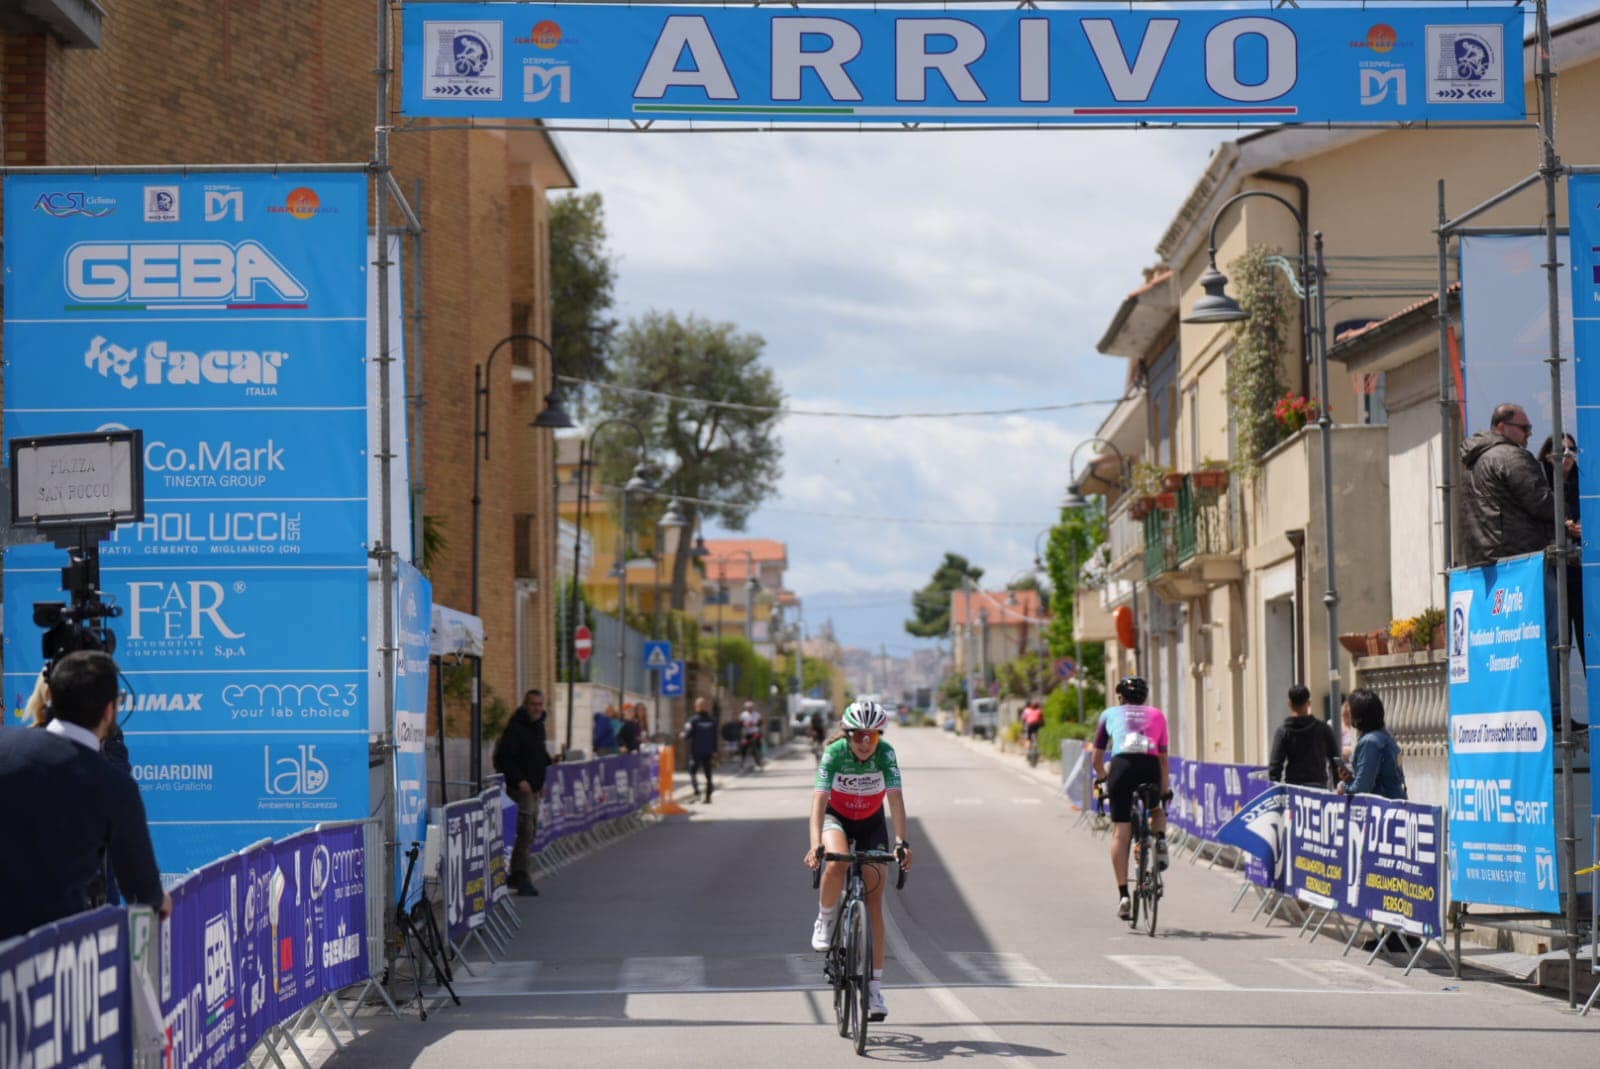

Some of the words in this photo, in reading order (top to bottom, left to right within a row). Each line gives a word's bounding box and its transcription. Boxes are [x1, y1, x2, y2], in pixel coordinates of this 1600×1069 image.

[633, 15, 1299, 103] ARRIVO
[64, 240, 309, 302] GEBA
[145, 341, 279, 385] facar
[246, 388, 278, 396] ITALIA
[143, 438, 286, 472] Co.Mark
[163, 475, 217, 487] TINEXTA
[219, 475, 267, 487] GROUP
[99, 546, 132, 554] FATTI
[144, 546, 199, 554] CEMENTO
[210, 545, 275, 554] MIGLIANICO
[280, 545, 301, 555] (CH)
[231, 708, 264, 719] your
[271, 706, 294, 718] lab
[300, 706, 351, 718] choice
[132, 764, 213, 781] OGIARDINI
[1450, 779, 1515, 823] DIEMME
[1513, 800, 1549, 825] SPORT
